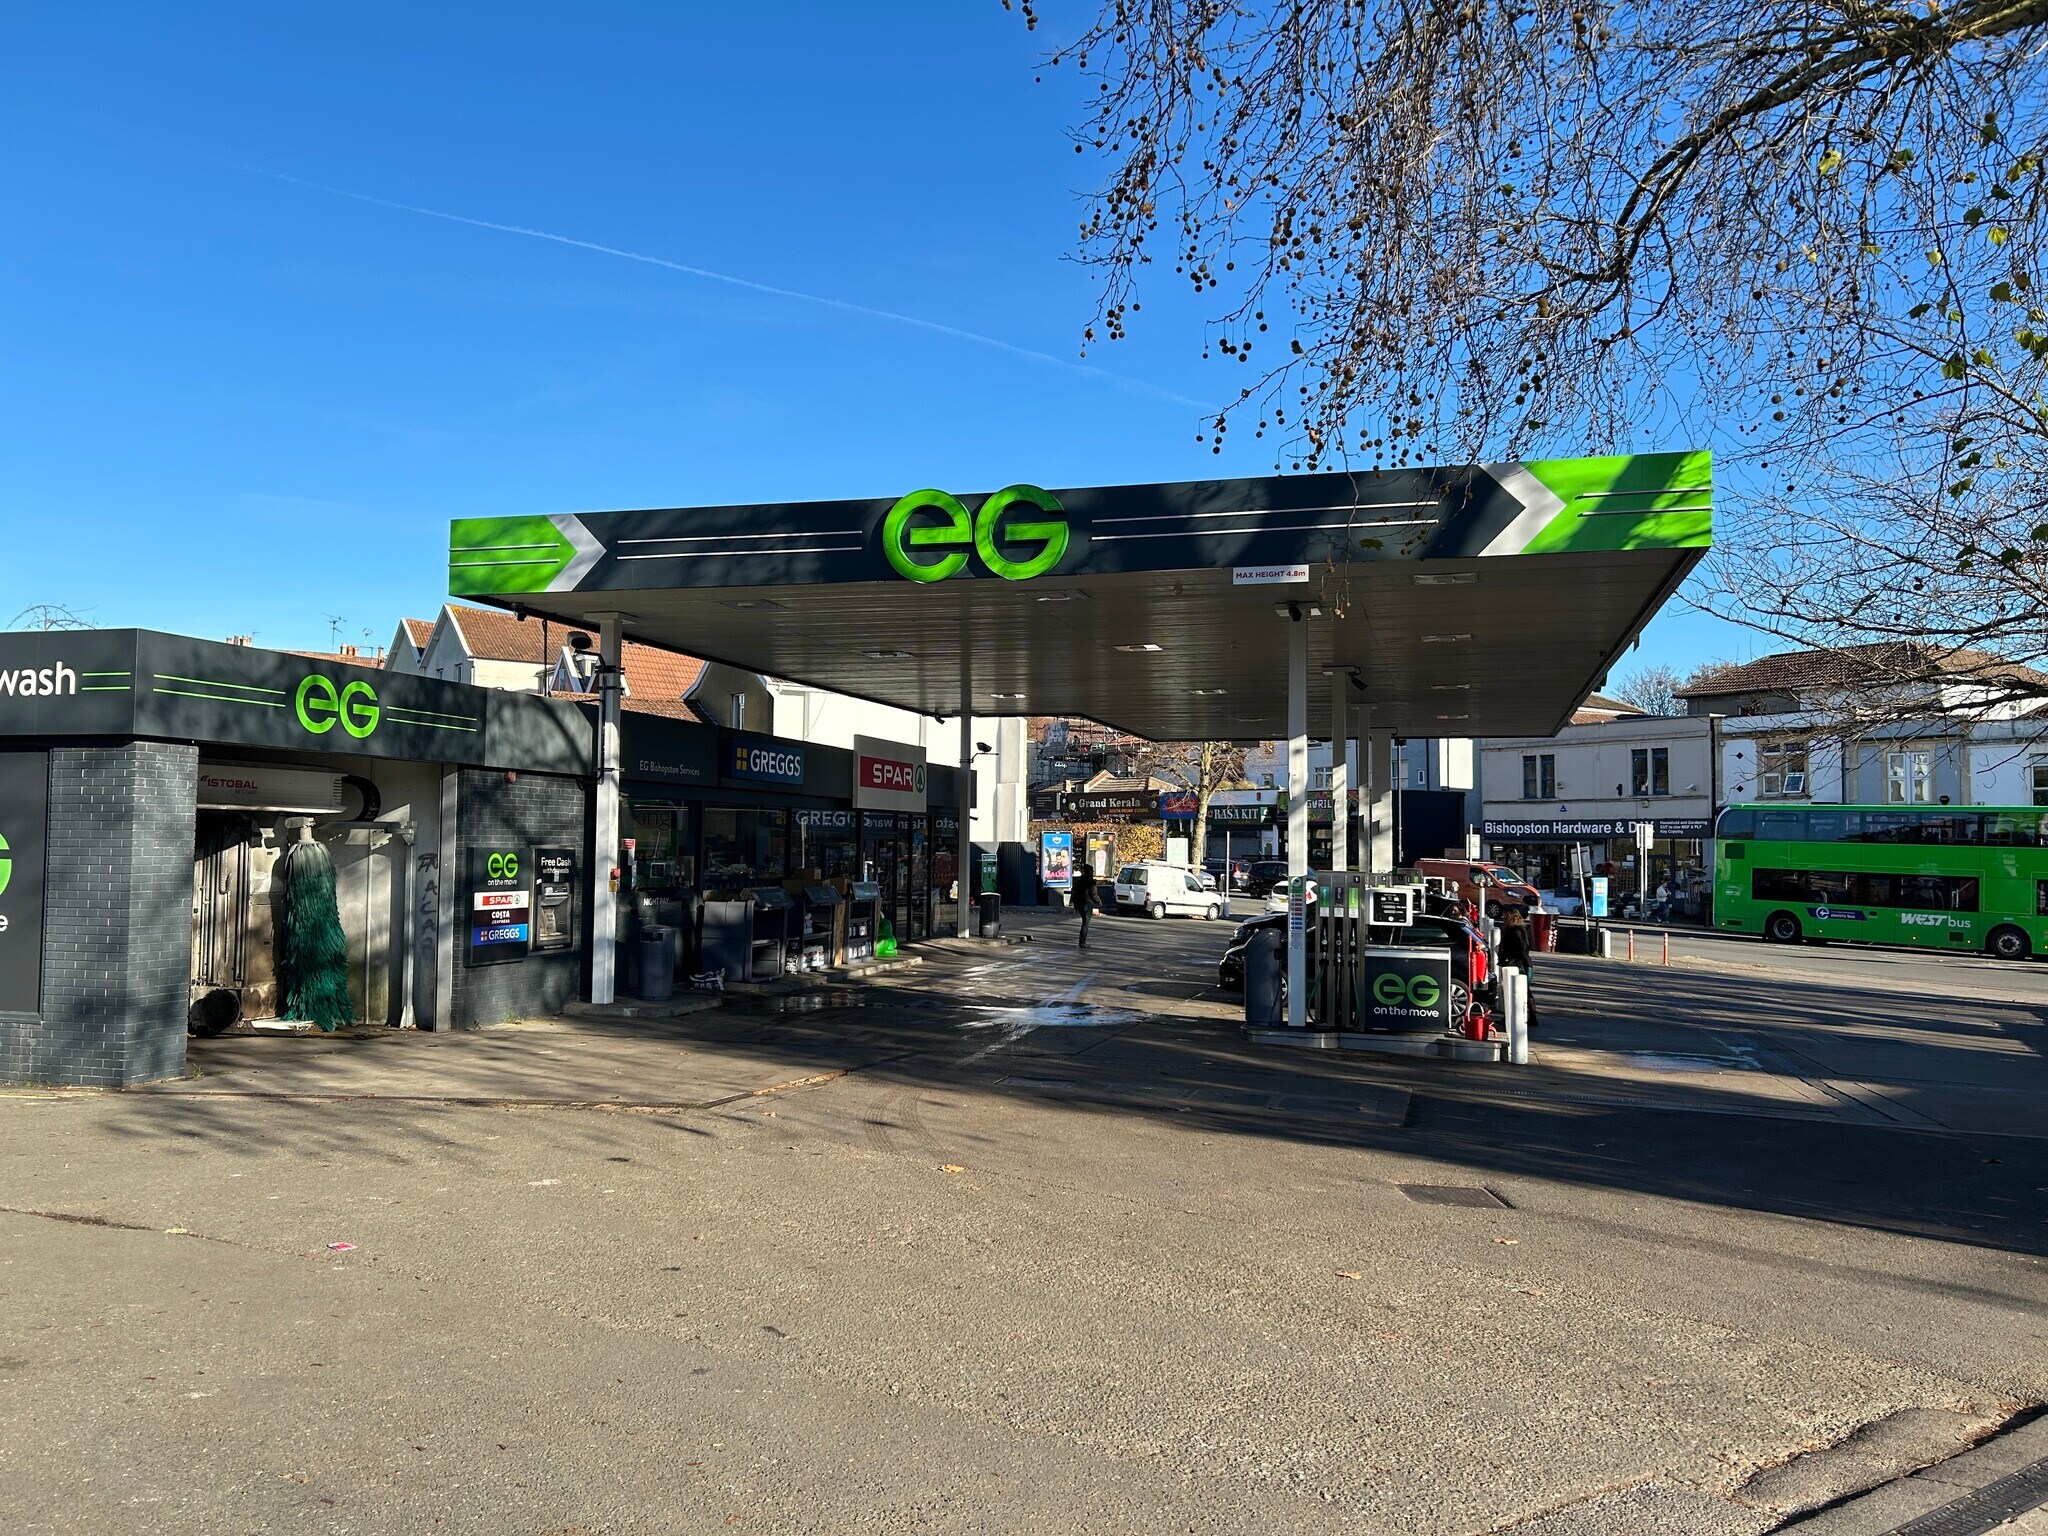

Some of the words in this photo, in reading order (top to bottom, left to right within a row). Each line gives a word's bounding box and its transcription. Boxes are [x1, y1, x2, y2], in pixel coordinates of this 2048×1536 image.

[0, 661, 76, 697] wash
[639, 760, 649, 771] EG
[650, 761, 679, 776] Bishopston
[680, 764, 700, 776] Services
[750, 750, 801, 777] GREGGS
[873, 763, 913, 787] SPAR
[207, 778, 258, 789] ISTOBAL
[1079, 798, 1107, 808] Grand
[1109, 797, 1141, 807] Kerala
[1214, 808, 1239, 820] RASA
[1485, 821, 1550, 836] Bishopston
[1553, 821, 1612, 834] Hardware
[1615, 821, 1625, 834] &
[541, 857, 555, 866] Free
[556, 857, 572, 866] Cash
[489, 896, 513, 905] SPAR
[643, 897, 660, 906] NIGHT
[660, 897, 670, 905] PAY
[491, 910, 510, 919] COSTA
[488, 928, 520, 940] GREGGS
[1389, 1006, 1407, 1015] the
[1409, 1009, 1440, 1017] move
